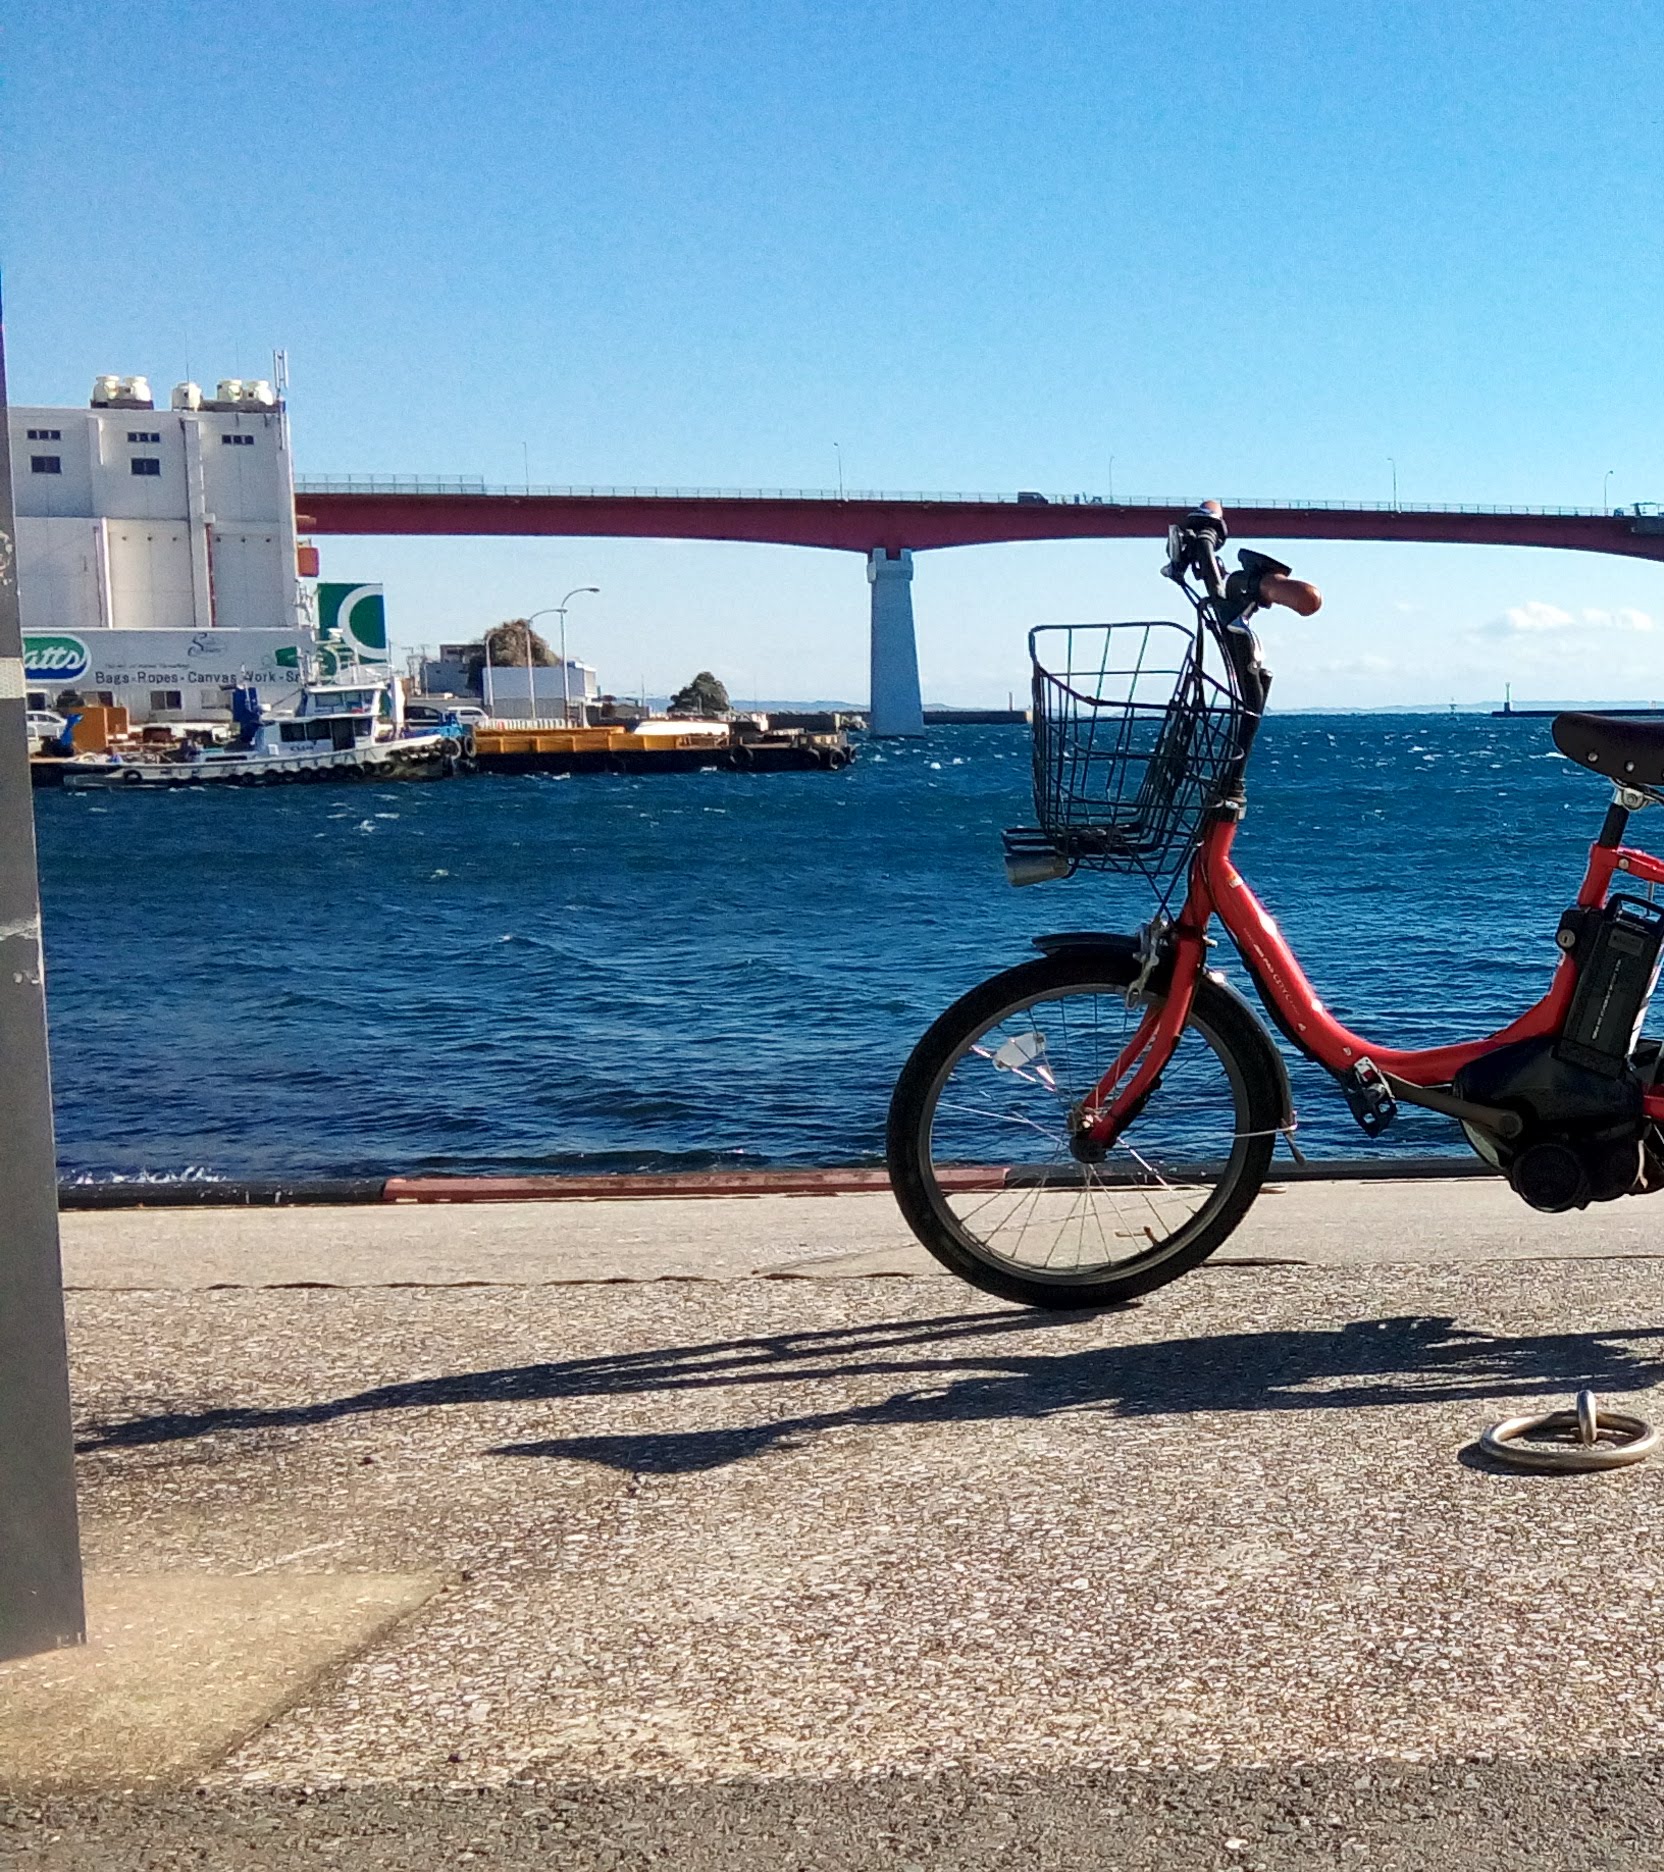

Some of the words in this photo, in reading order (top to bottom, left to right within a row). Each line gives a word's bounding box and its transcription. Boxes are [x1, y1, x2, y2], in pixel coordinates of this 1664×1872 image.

[24, 646, 87, 670] atts
[95, 670, 129, 685] Bags
[137, 670, 179, 685] Ropes
[188, 671, 237, 684] Canvas
